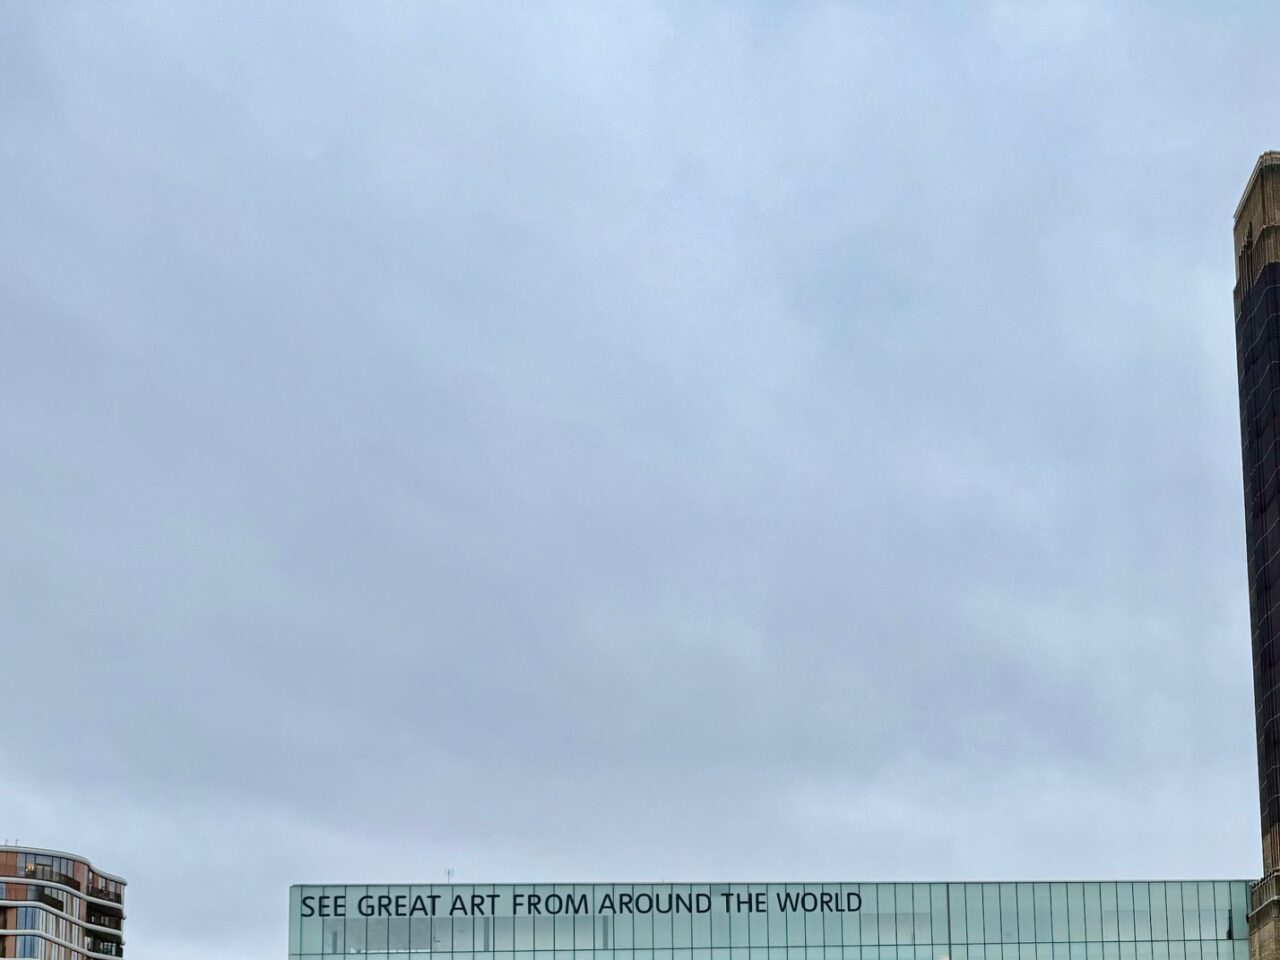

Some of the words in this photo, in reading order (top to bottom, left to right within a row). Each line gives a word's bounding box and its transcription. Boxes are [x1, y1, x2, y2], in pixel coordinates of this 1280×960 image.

[301, 895, 346, 917] SEE
[357, 895, 441, 917] GREAT
[449, 894, 500, 916] ART
[512, 893, 589, 915] FROM
[598, 893, 712, 914] AROUND
[720, 892, 767, 913] THE
[776, 892, 862, 913] WORLD
